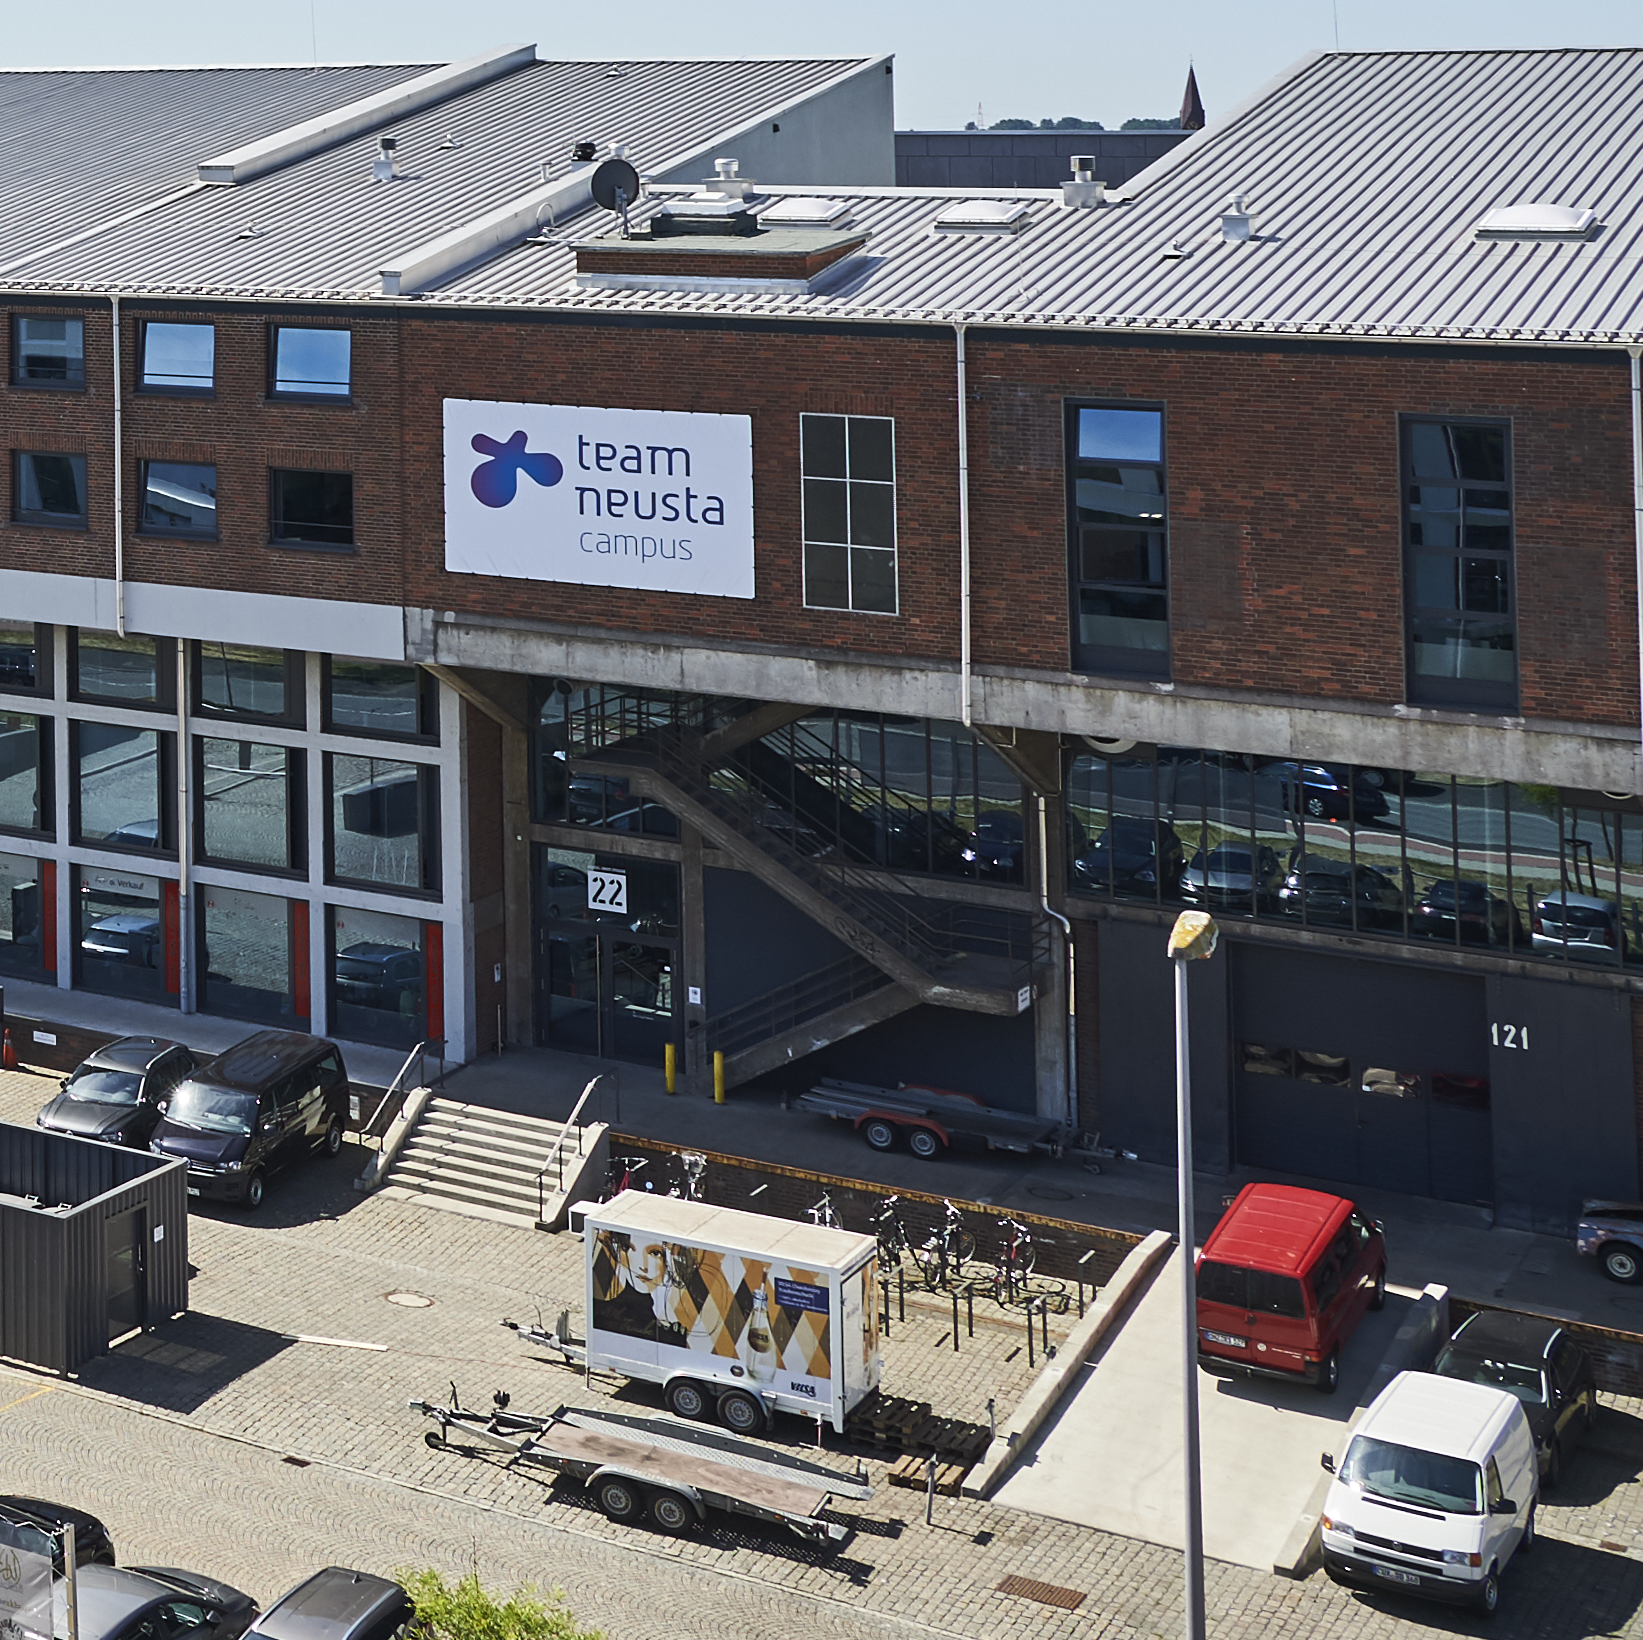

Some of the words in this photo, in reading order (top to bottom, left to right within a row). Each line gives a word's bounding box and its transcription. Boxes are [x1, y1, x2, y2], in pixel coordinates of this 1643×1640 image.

[578, 434, 691, 477] team
[575, 486, 724, 526] neusta
[580, 532, 693, 563] campus
[117, 878, 145, 891] Verkauf
[592, 876, 623, 906] 22
[1491, 1022, 1529, 1050] 121
[790, 1381, 817, 1397] VILSA
